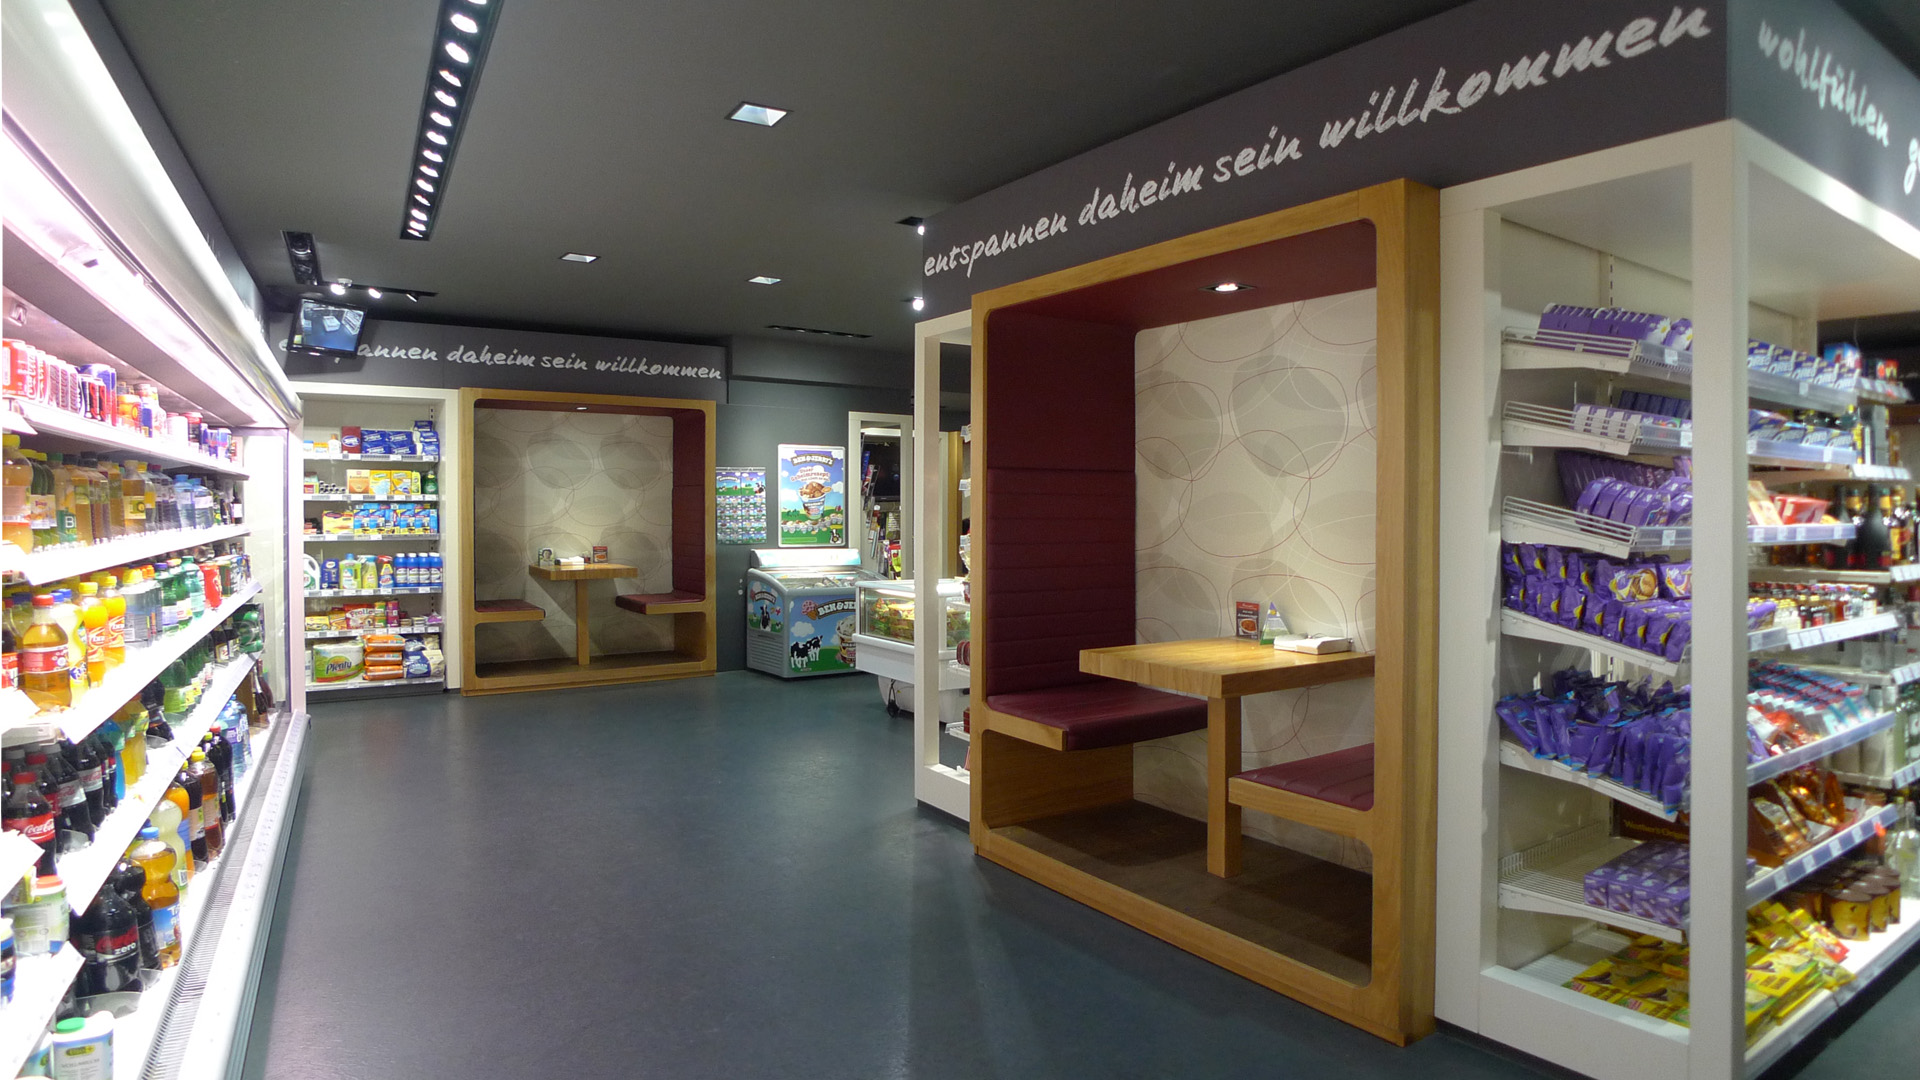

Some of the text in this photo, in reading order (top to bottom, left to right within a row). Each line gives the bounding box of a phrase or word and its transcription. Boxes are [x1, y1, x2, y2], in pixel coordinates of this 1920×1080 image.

[1758, 19, 1890, 148] wohlfühlen
[924, 5, 1712, 278] entspannen daheim sein willkommen
[278, 338, 722, 380] eannen daheim sein willkommen
[326, 660, 353, 675] Plenty
[114, 941, 137, 955] zero
